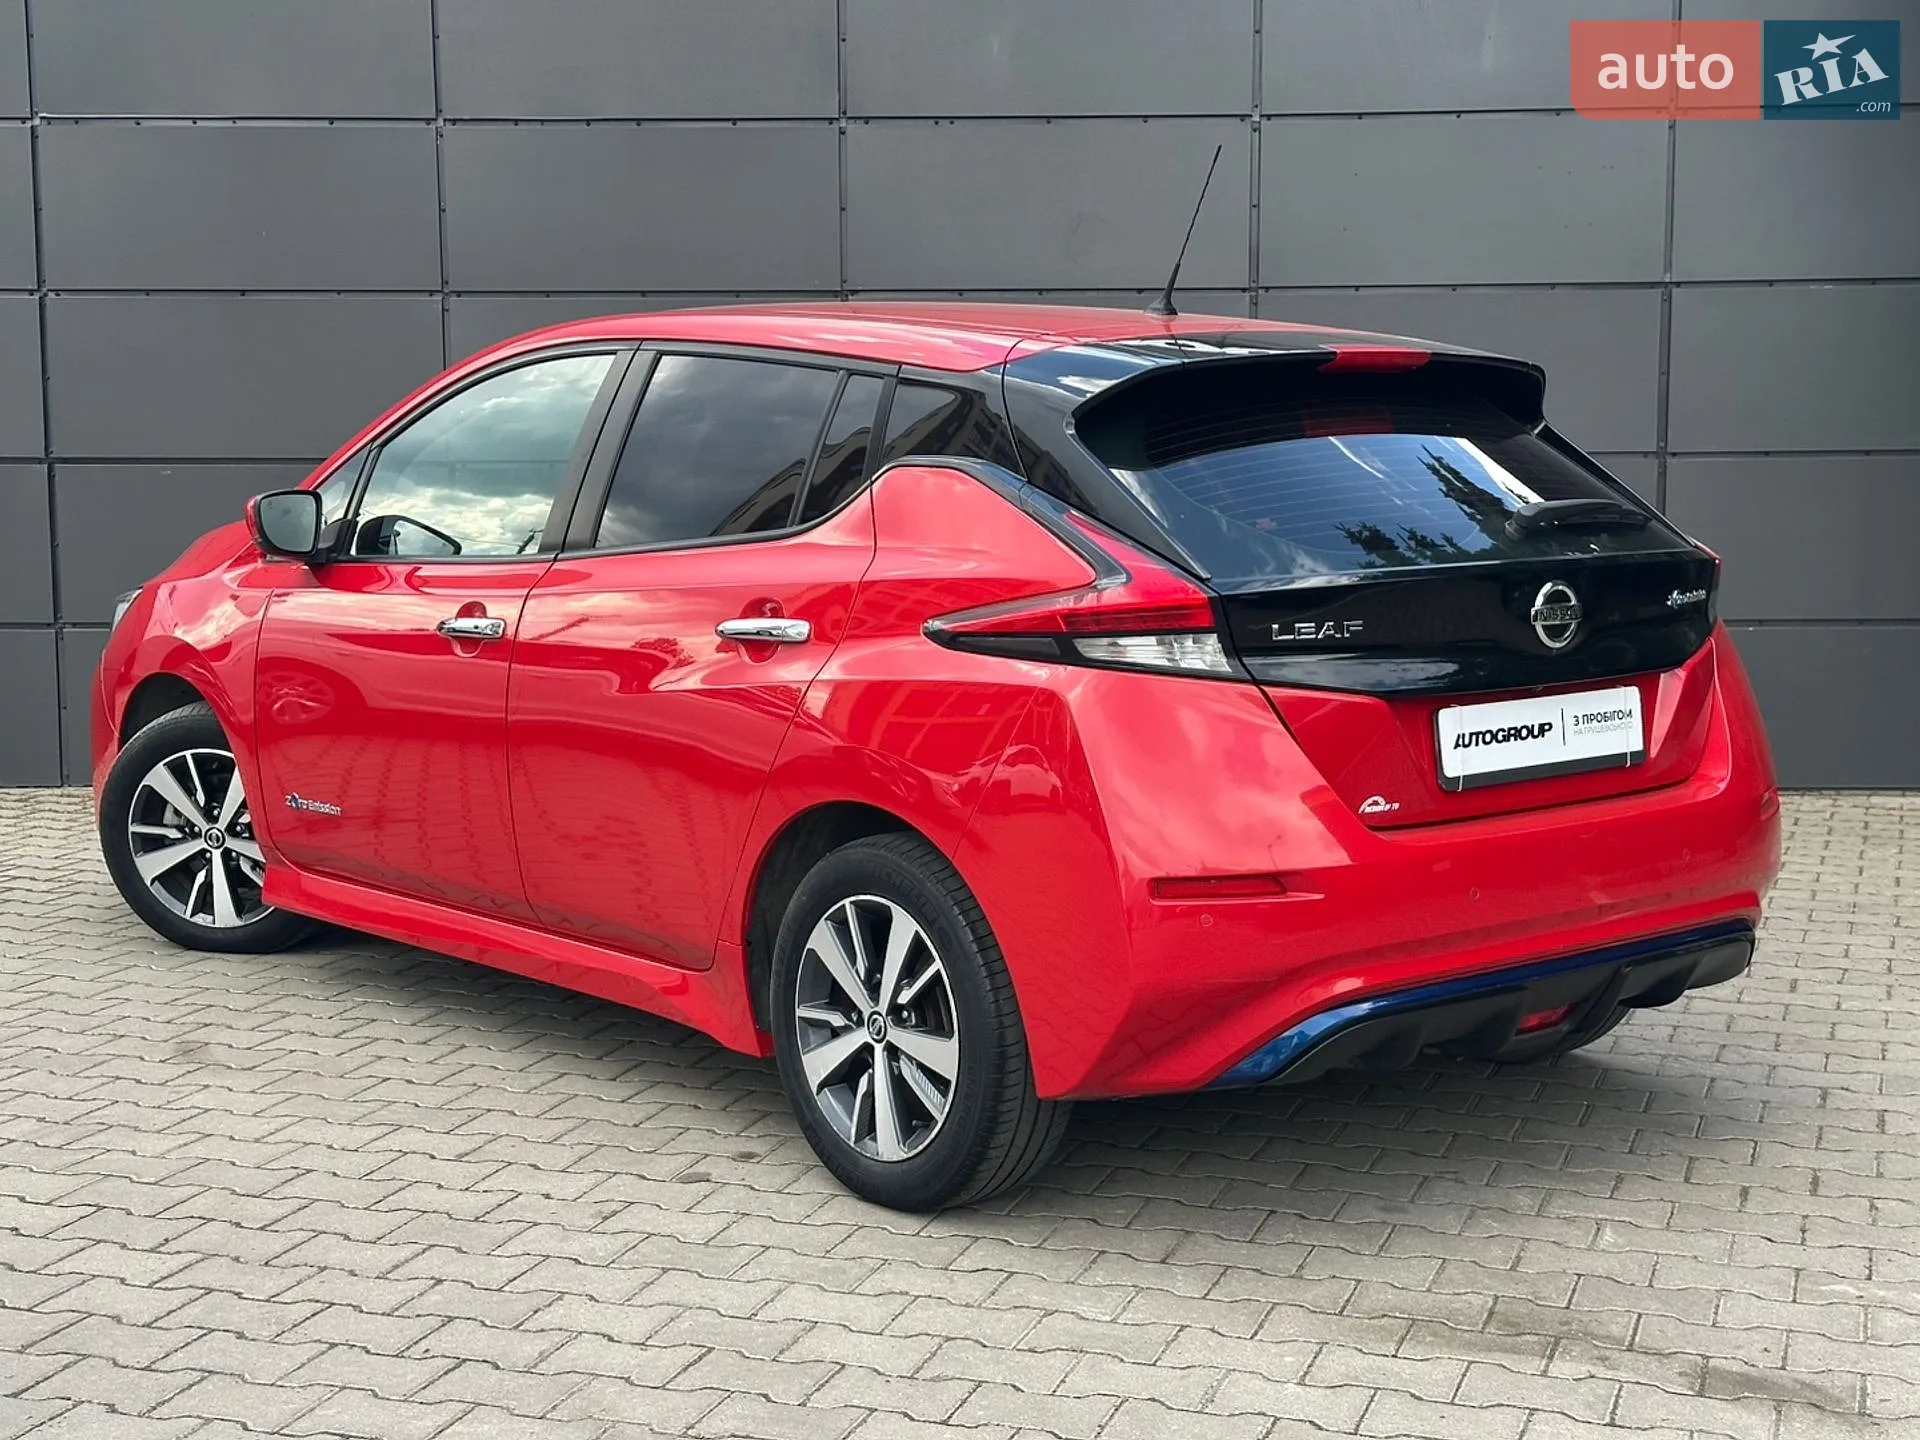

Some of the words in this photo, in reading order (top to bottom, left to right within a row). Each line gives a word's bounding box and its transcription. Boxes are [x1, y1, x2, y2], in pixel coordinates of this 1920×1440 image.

[1272, 620, 1363, 640] LEAF
[1582, 708, 1633, 725] ПРОБІГОМ
[1453, 722, 1553, 750] AUTOGROUP
